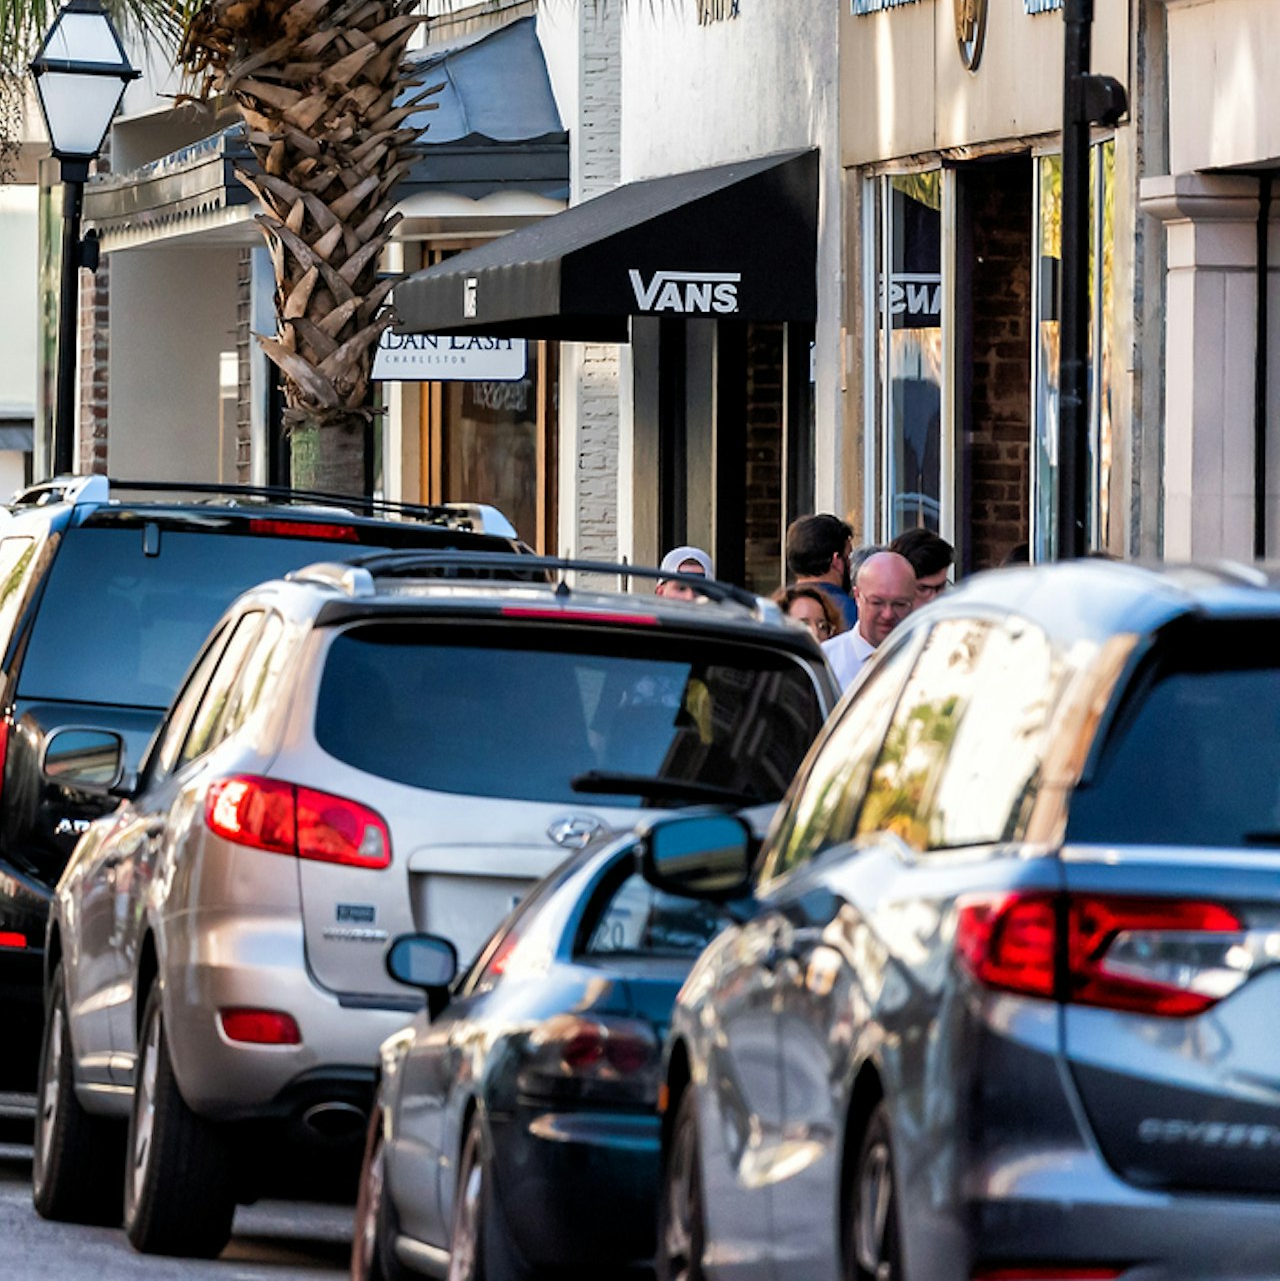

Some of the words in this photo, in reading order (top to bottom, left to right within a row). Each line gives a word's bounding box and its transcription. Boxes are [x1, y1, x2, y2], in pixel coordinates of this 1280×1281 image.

[628, 269, 741, 313] VANS
[380, 330, 439, 350] DAN
[384, 354, 467, 364] CHARLESTON
